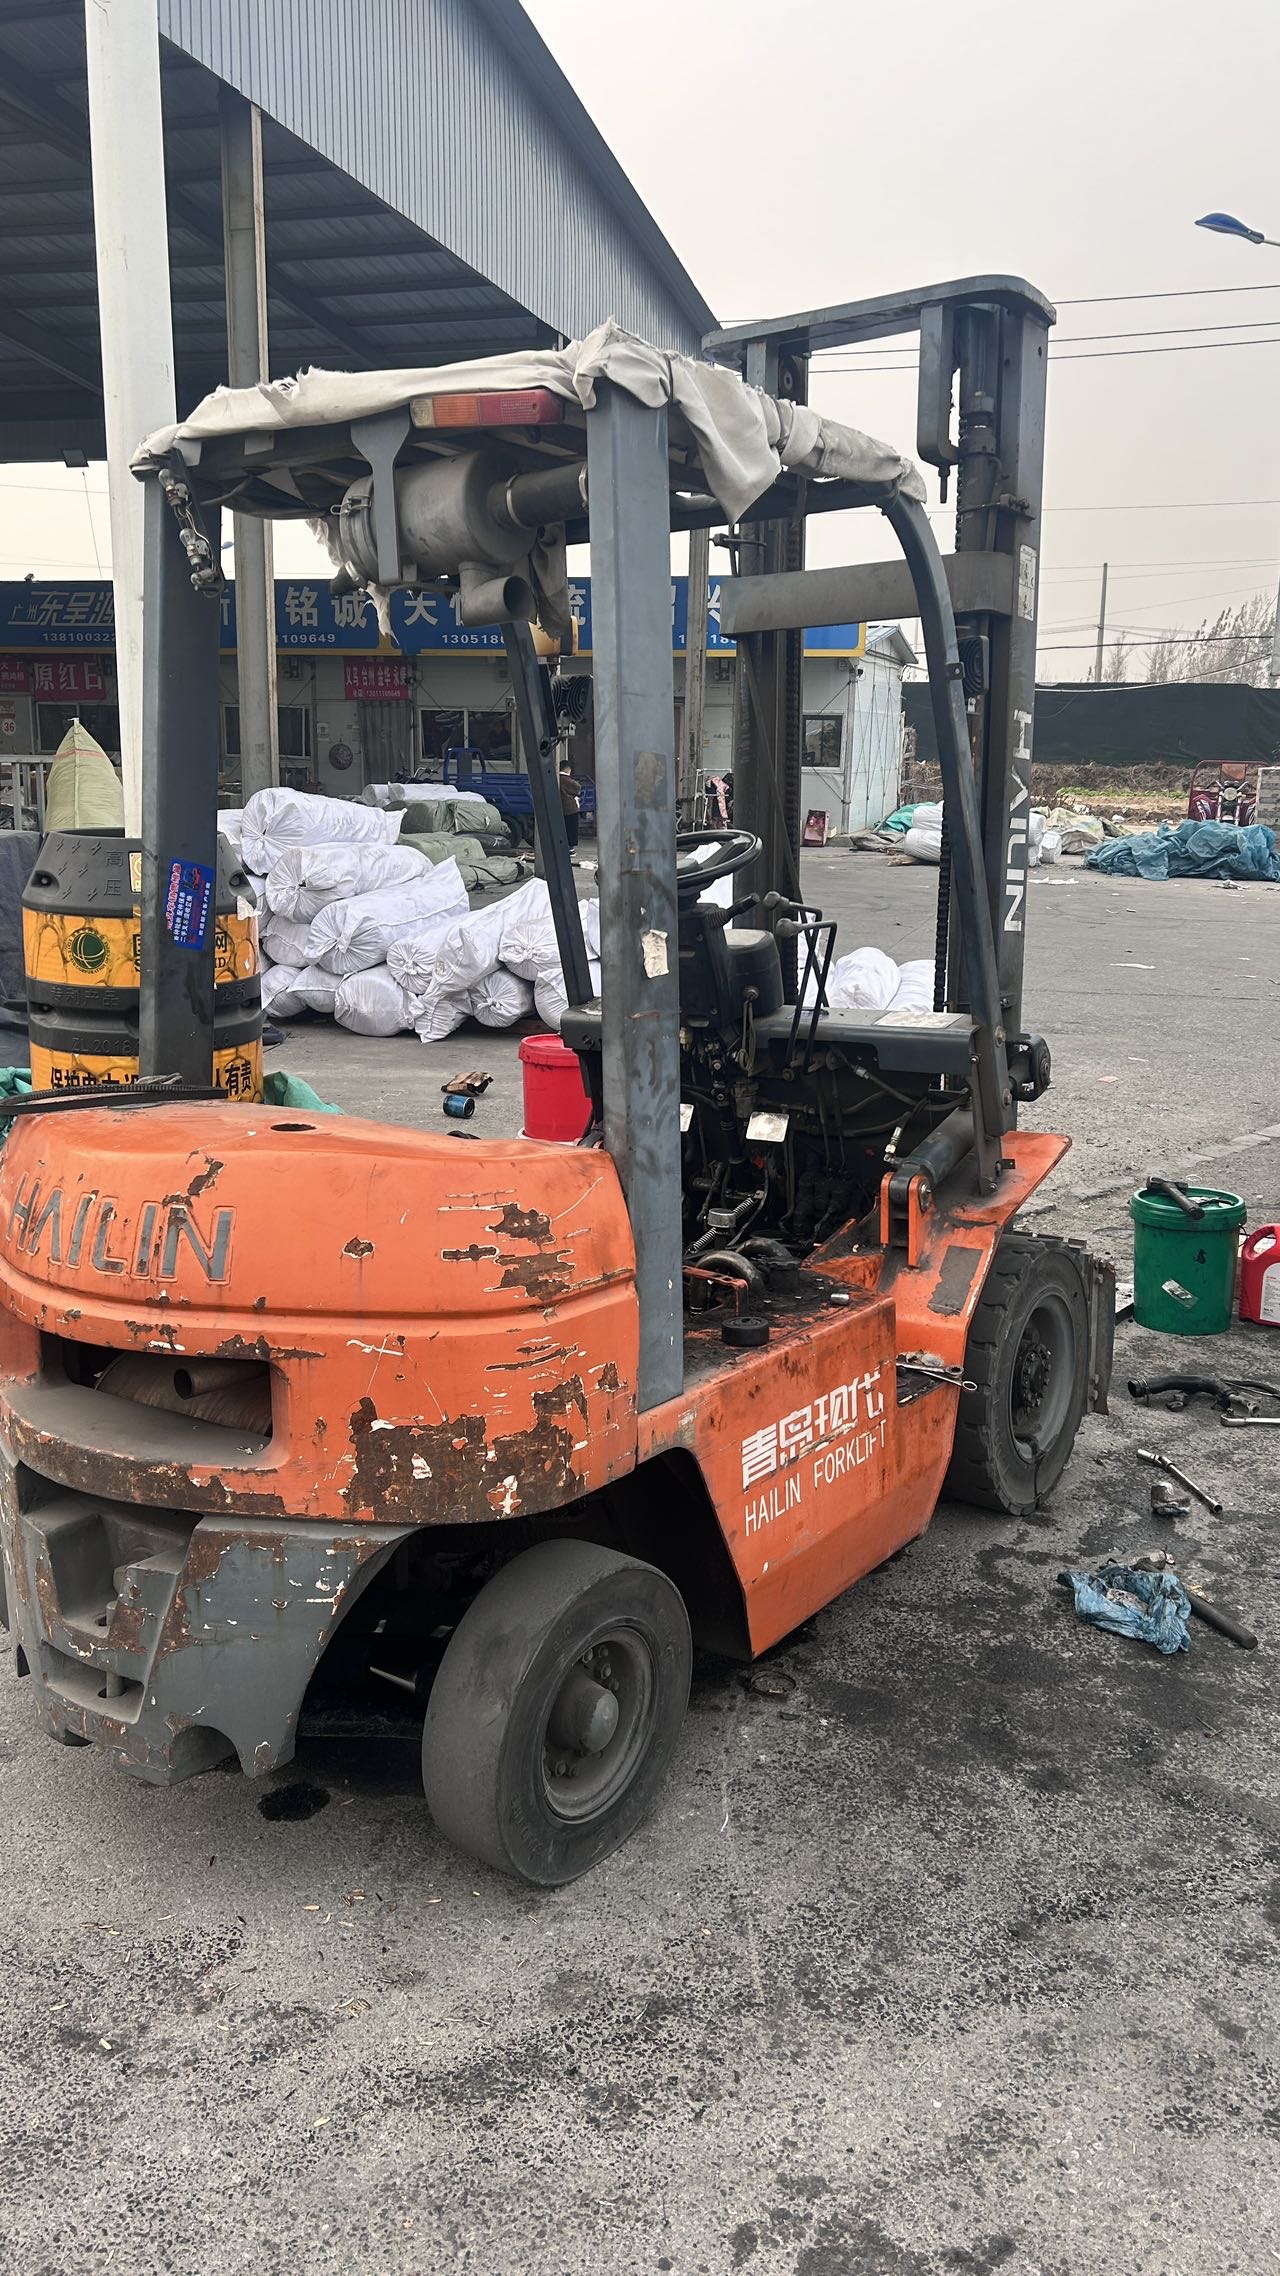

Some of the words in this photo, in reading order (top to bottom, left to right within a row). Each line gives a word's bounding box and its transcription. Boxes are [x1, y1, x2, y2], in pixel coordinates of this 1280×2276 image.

[276, 633, 336, 643] 109649
[4, 722, 15, 732] 36
[6, 1171, 237, 1286] HAILIN
[741, 1369, 884, 1493] 青岛现代
[744, 1472, 802, 1537] HAILIN
[813, 1418, 887, 1489] FORKLIFT
